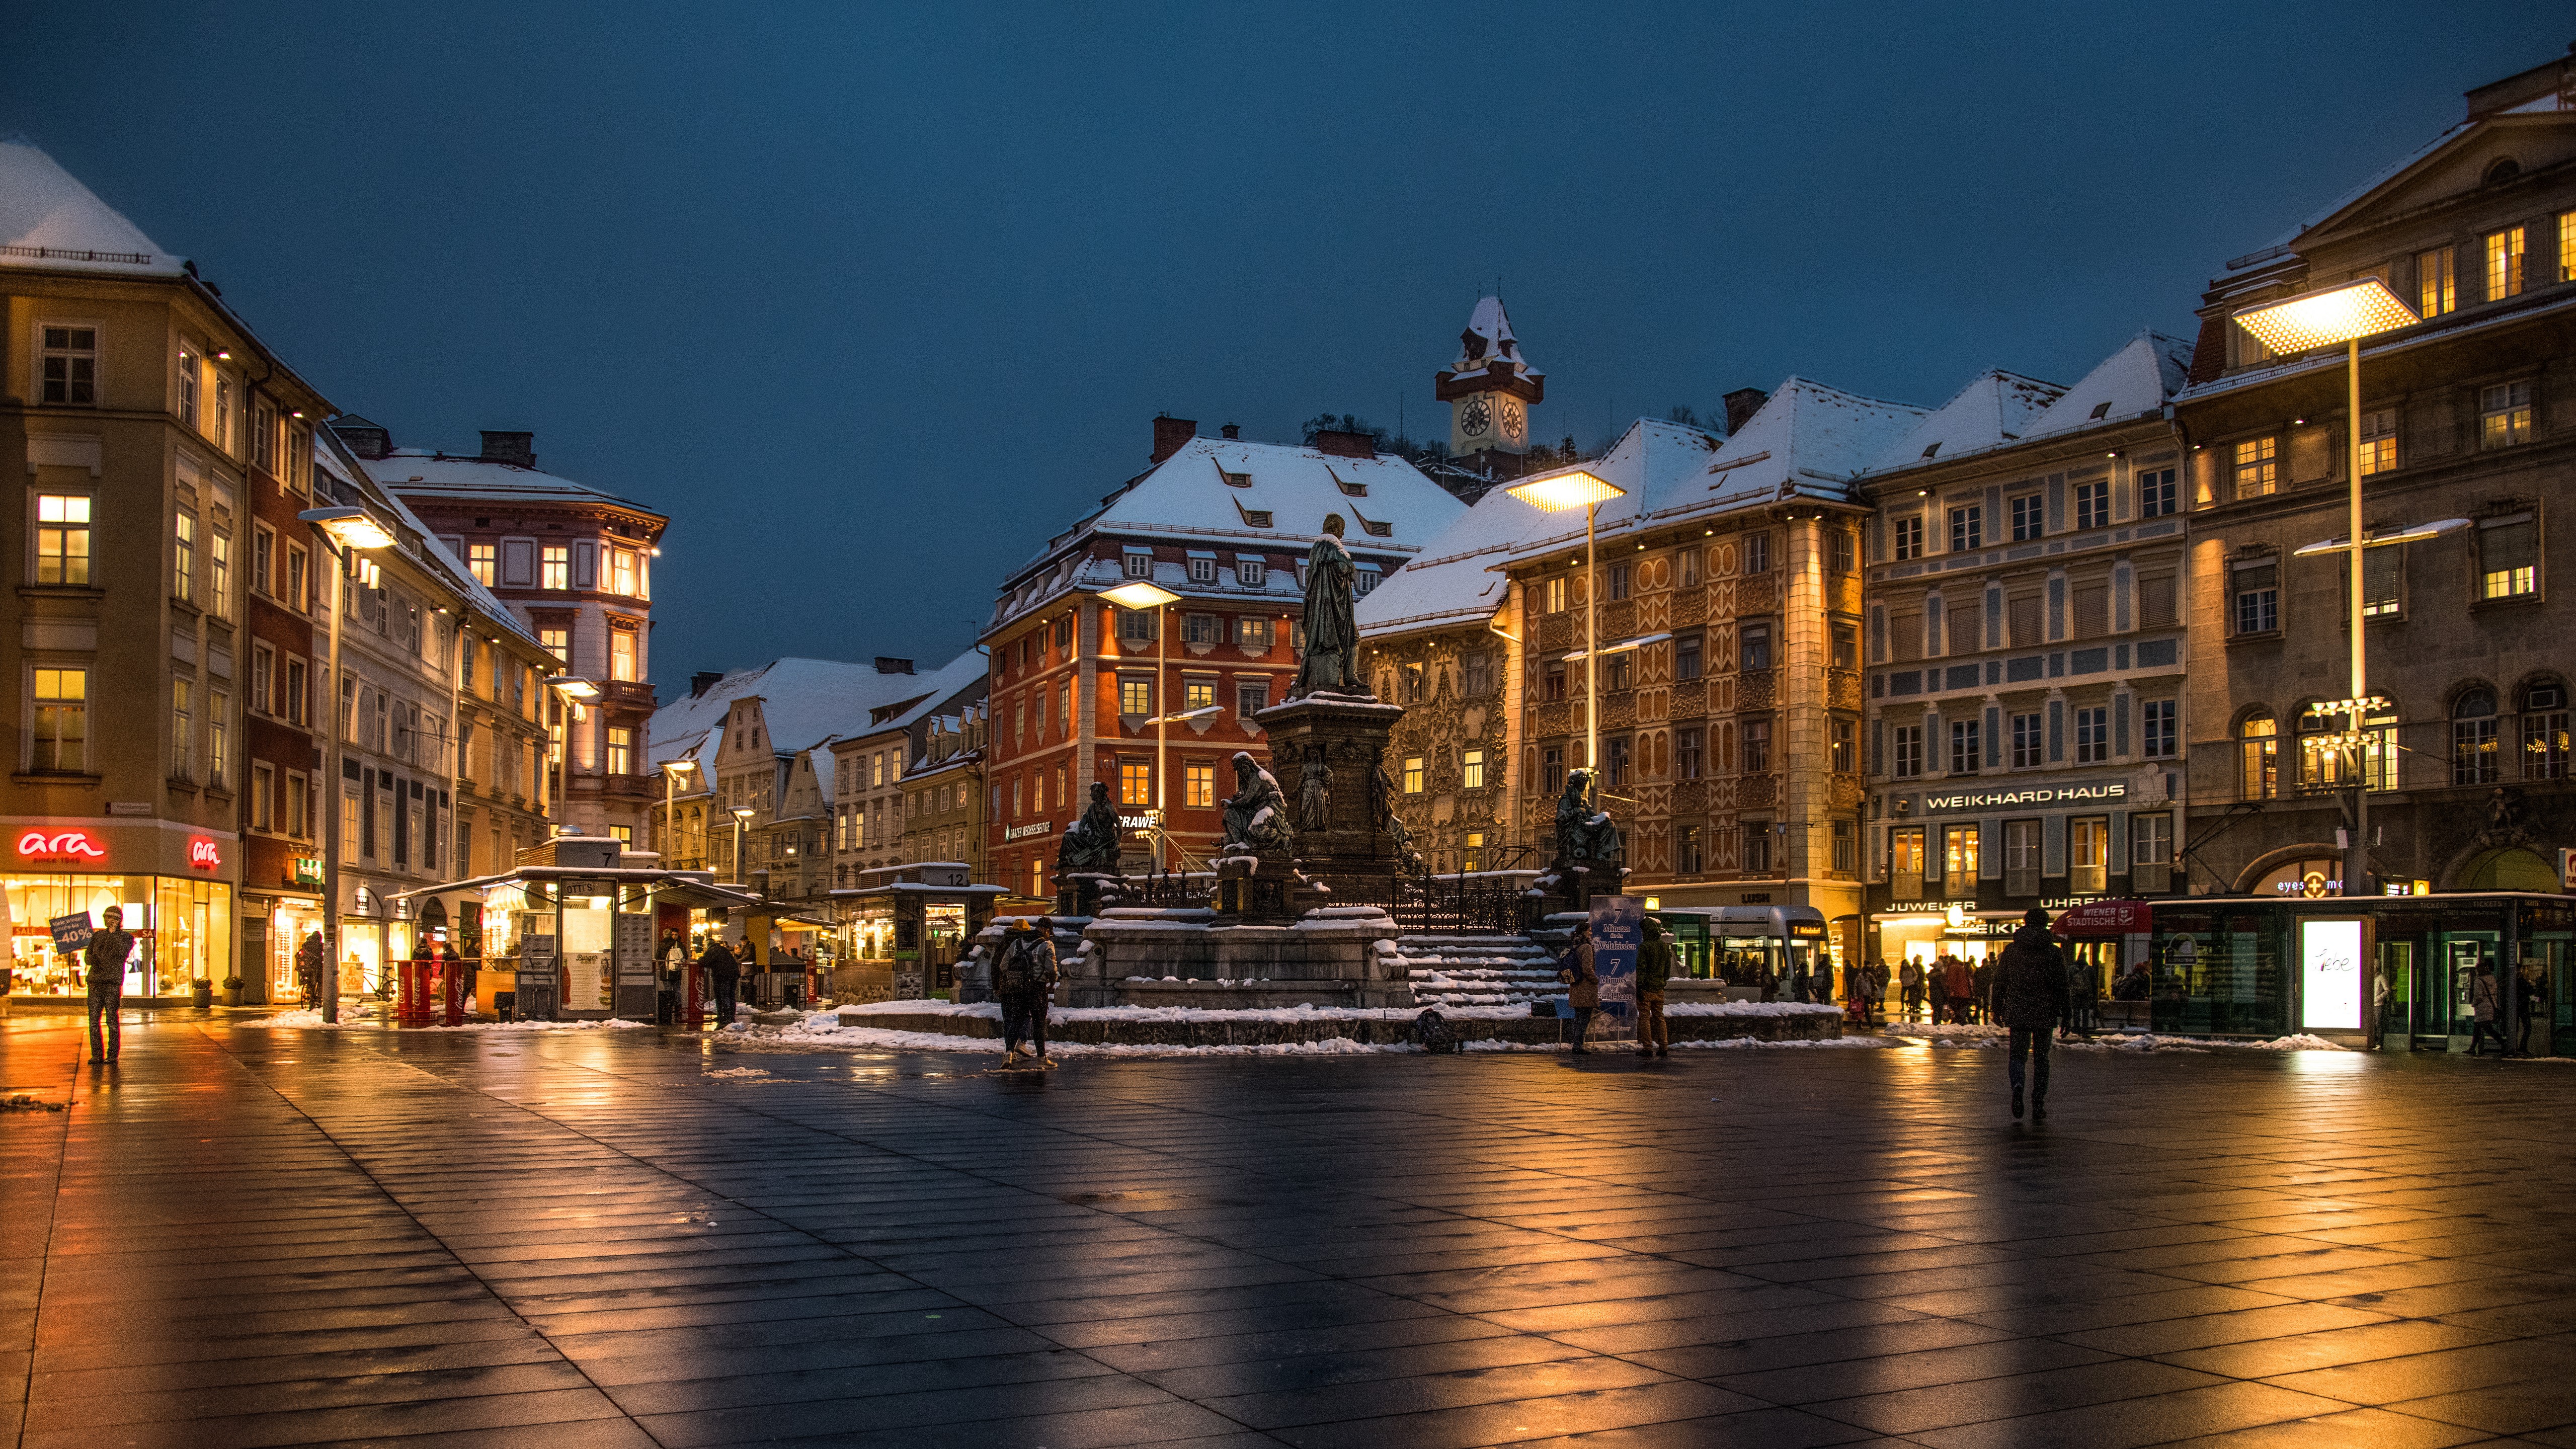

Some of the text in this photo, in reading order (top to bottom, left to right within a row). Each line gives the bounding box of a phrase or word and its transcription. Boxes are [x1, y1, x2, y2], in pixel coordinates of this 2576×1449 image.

[1927, 784, 2126, 809] WEIKHARD HAUS
[1010, 821, 1051, 839] GRAZER WECHSELSEITIGE
[19, 833, 104, 856] ara
[193, 841, 221, 864] ara
[602, 853, 612, 867] 7
[948, 873, 963, 886] 12
[2566, 875, 2576, 883] rue
[2277, 880, 2343, 893] eyes mo
[1741, 893, 1770, 904] LUSH
[1615, 908, 1623, 924] 7
[2083, 908, 2116, 916] WIENER
[142, 930, 154, 938] SA
[1603, 924, 1631, 932] Minuten
[56, 927, 92, 943] -40%
[1597, 941, 1636, 950] Weltfrieden
[576, 954, 598, 962] Burger
[1611, 958, 1621, 975] 7
[1600, 976, 1627, 984] Minutes
[1597, 992, 1632, 1001] orld-Peace
